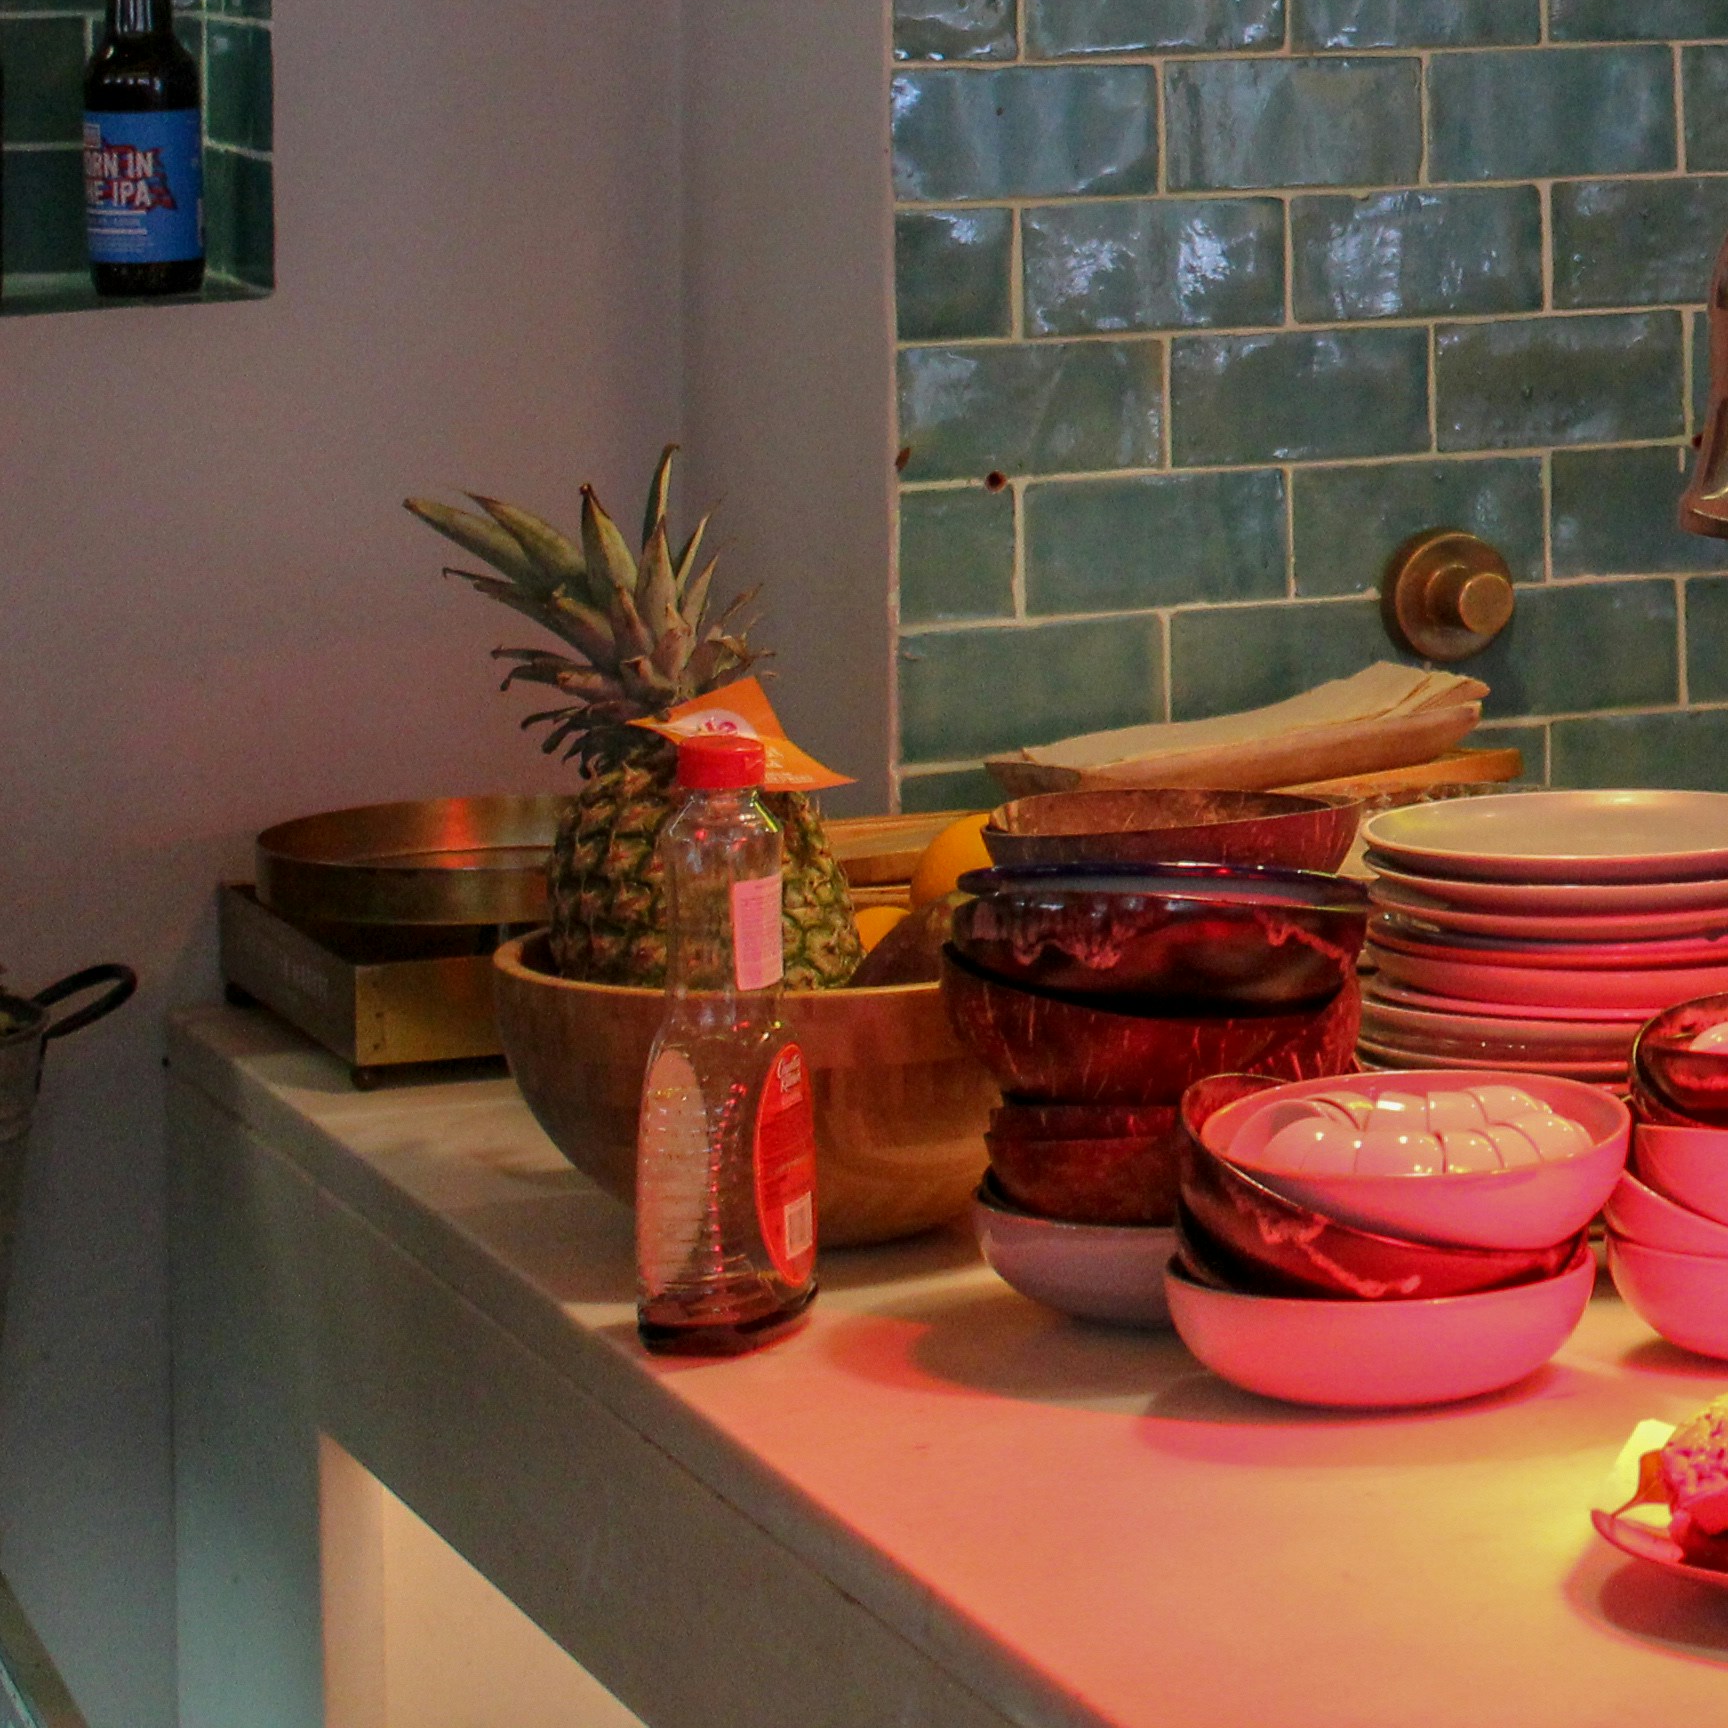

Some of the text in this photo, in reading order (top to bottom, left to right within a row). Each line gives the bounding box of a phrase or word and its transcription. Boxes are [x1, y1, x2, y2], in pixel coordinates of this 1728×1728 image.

[84, 149, 153, 178] ORN IN
[112, 178, 151, 208] IPA
